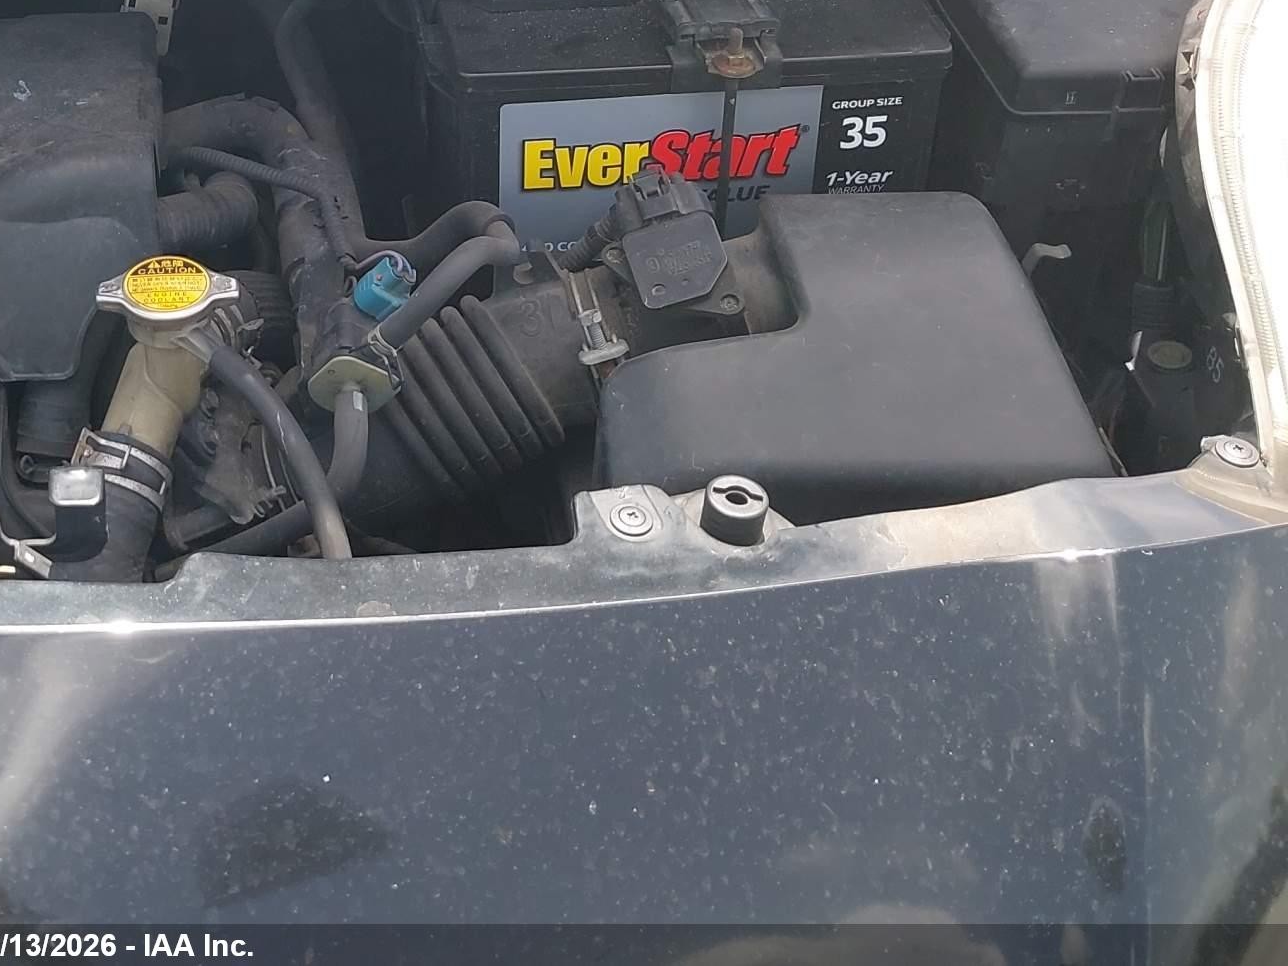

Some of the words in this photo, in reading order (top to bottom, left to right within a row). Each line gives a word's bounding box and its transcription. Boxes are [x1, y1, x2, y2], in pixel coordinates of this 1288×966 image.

[832, 98, 875, 110] GROUP
[876, 96, 903, 107] SIZE
[839, 115, 888, 149] 35
[521, 123, 801, 191] EverStart
[826, 170, 893, 187] 1-Year
[827, 184, 885, 194] WARRANTY
[137, 266, 197, 275] CAUTION
